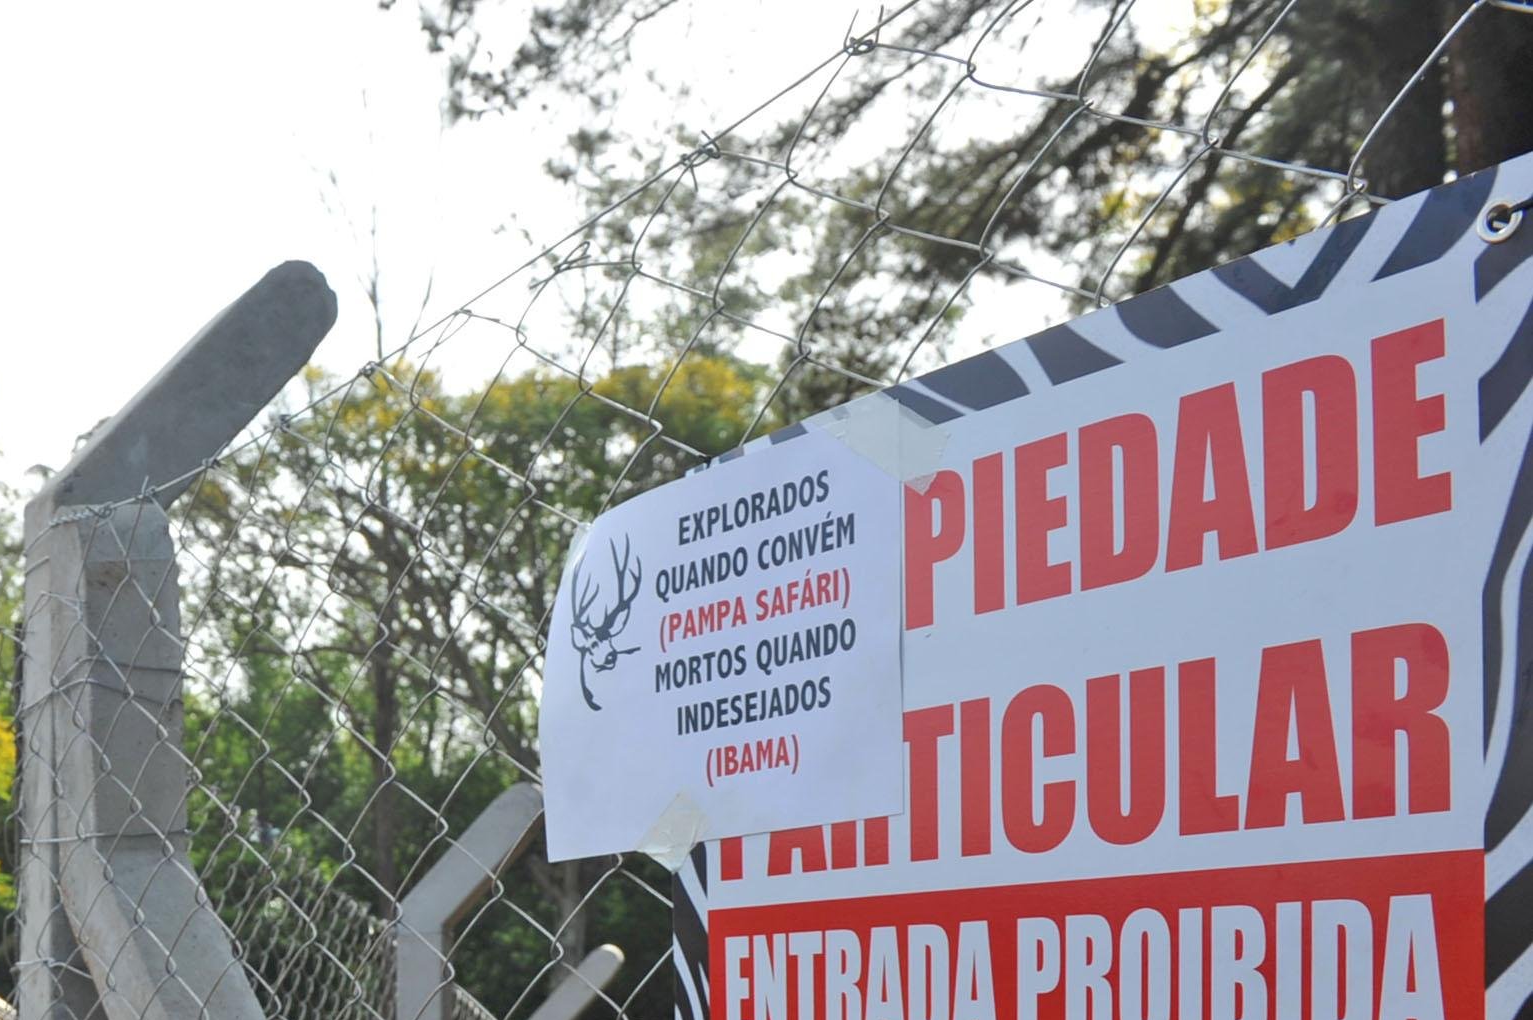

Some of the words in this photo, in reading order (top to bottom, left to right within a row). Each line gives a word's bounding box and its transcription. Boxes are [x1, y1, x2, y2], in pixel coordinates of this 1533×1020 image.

[678, 470, 829, 546] EXPLORADOS
[656, 547, 748, 603] QUANDO
[757, 511, 855, 571] CONVÉM
[659, 595, 747, 653] (PAMPA
[755, 567, 851, 624] SAFÁRI)
[655, 645, 746, 693] MORTOS
[756, 618, 857, 673] QUANDO
[677, 676, 832, 736] INDESEJADOS
[706, 735, 800, 788] (IBAMA)
[720, 622, 1451, 882] TICULAR
